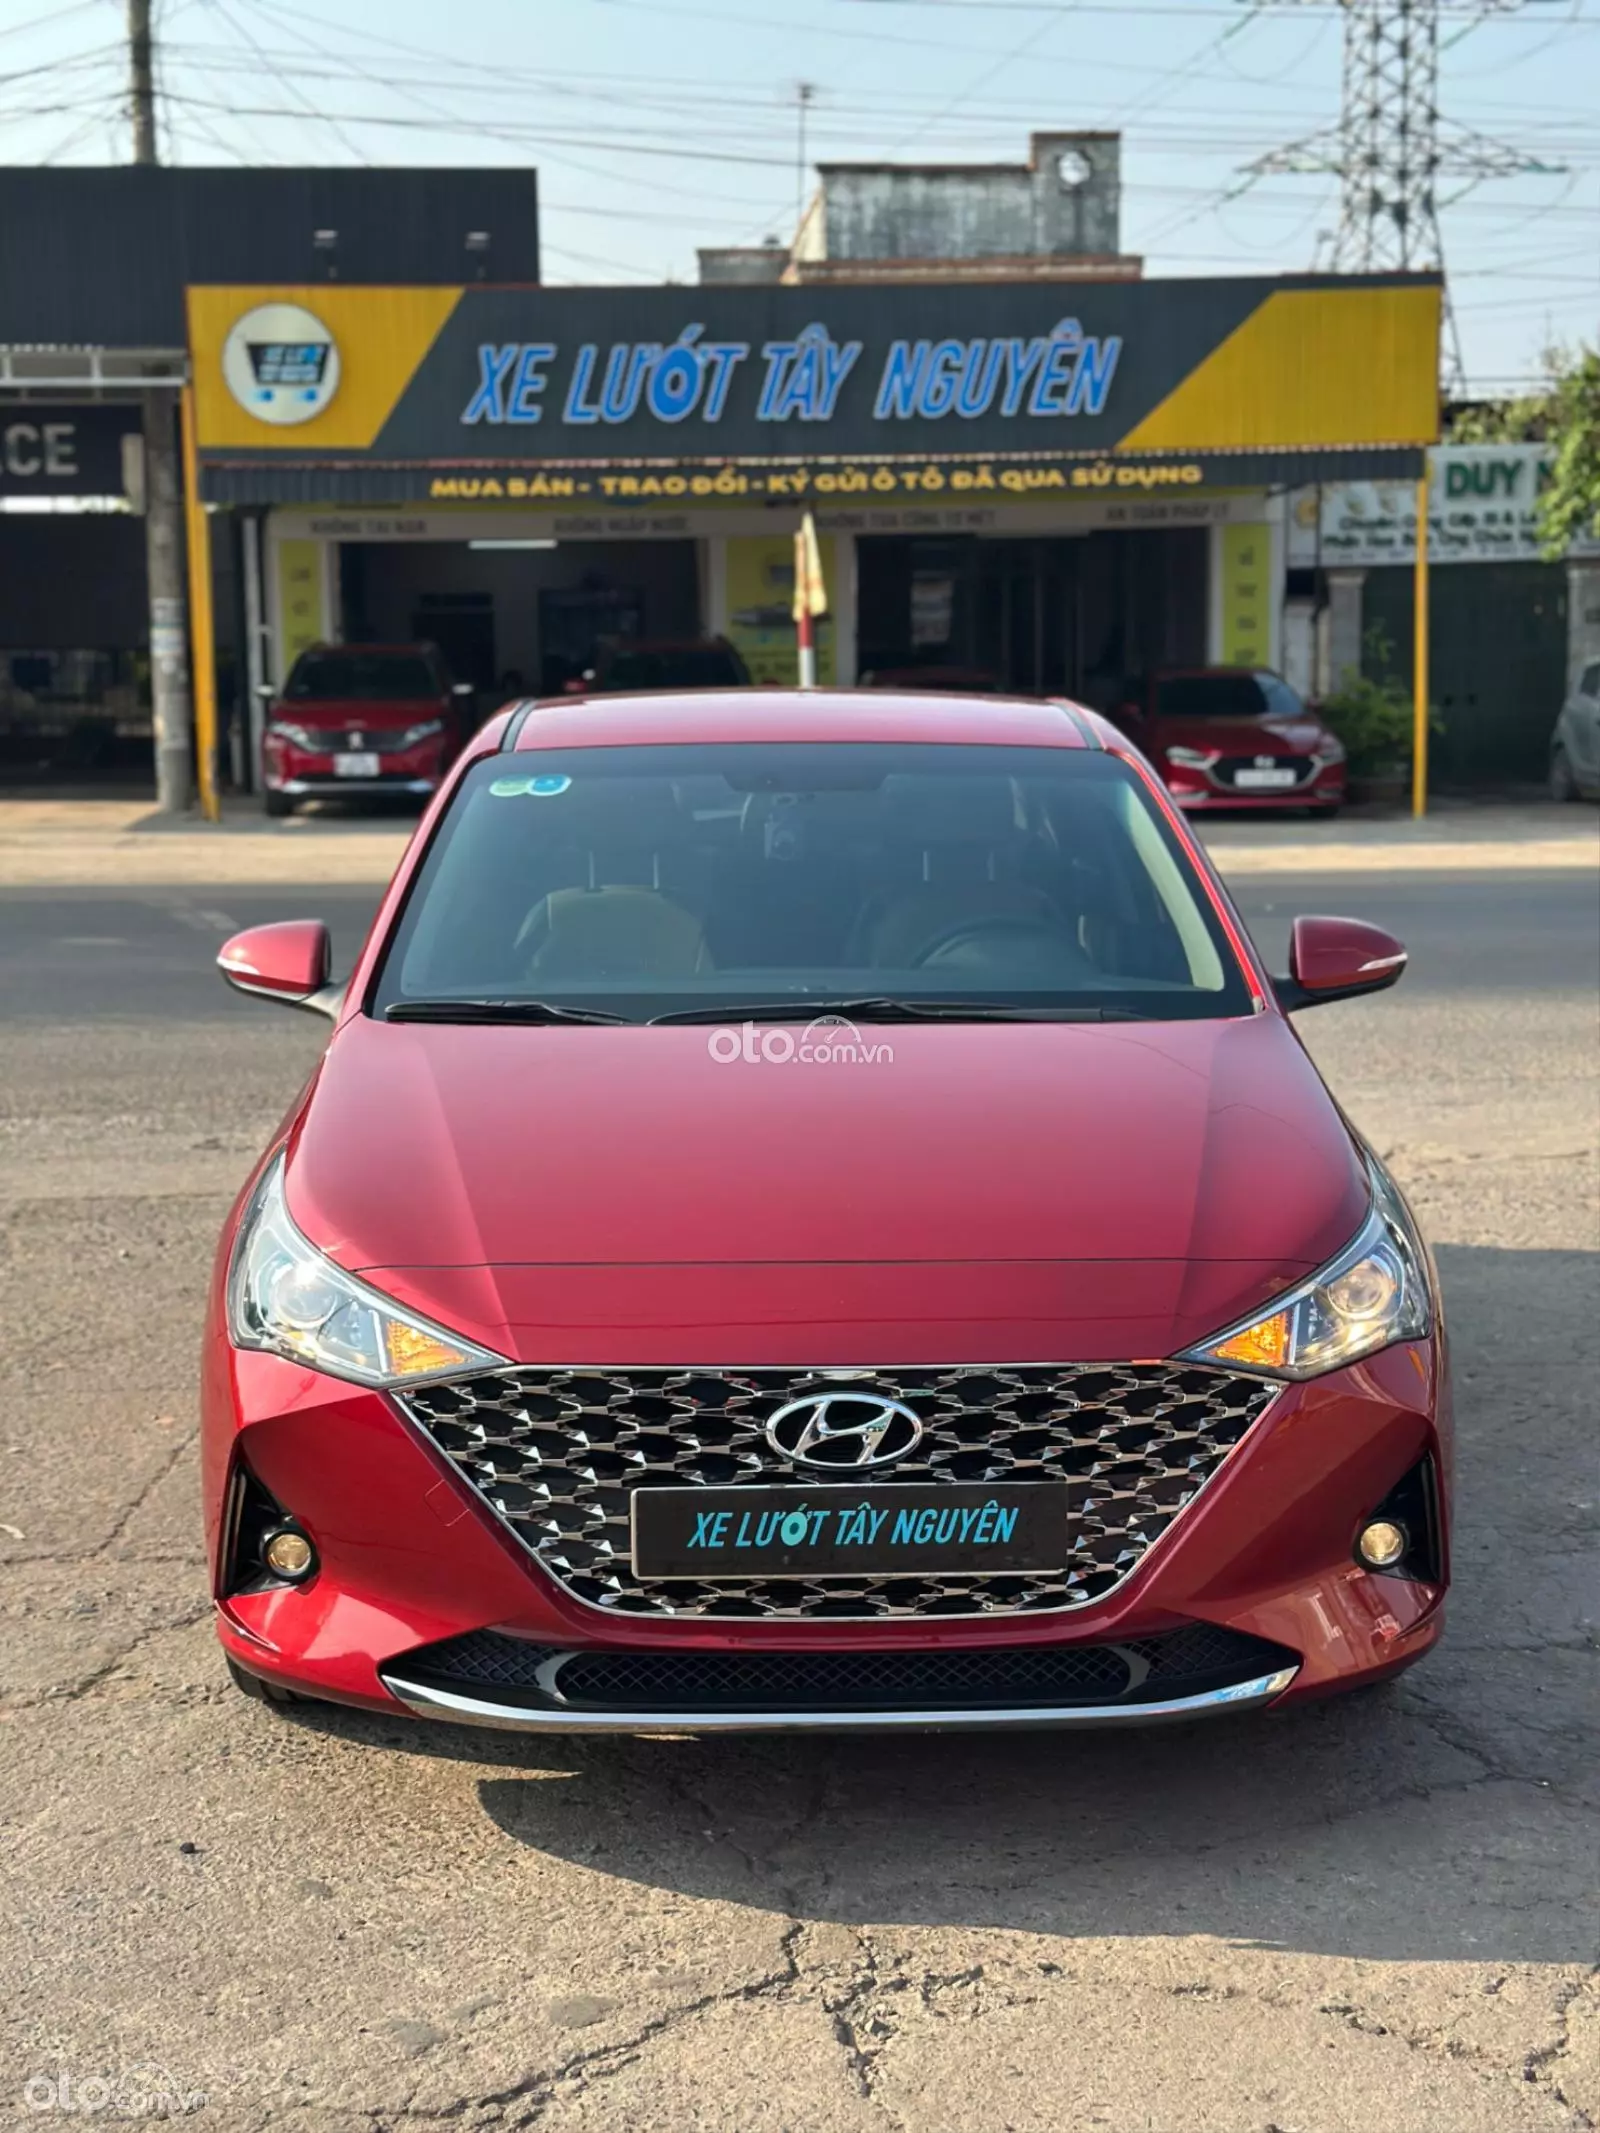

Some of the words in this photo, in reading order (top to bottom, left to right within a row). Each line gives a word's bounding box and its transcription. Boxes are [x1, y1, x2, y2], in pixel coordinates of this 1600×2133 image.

[460, 343, 557, 425] XE
[562, 322, 749, 424] LƯỚT
[757, 322, 862, 421] TÂY
[873, 317, 1122, 419] NGUYÊN
[0, 422, 79, 476] CE
[430, 477, 503, 498] MUA
[507, 471, 574, 497] BÁN
[598, 474, 687, 496] TRAO
[872, 466, 896, 491] Ô
[900, 465, 945, 491] TÔ
[1000, 469, 1065, 492] QUA
[1115, 464, 1203, 491] DỤNG
[1445, 459, 1522, 499] DUY
[687, 1512, 733, 1548] XE
[735, 1502, 831, 1547] LƯỚT
[834, 1501, 889, 1546] TÂY
[891, 1499, 1019, 1545] NGUYÊN
